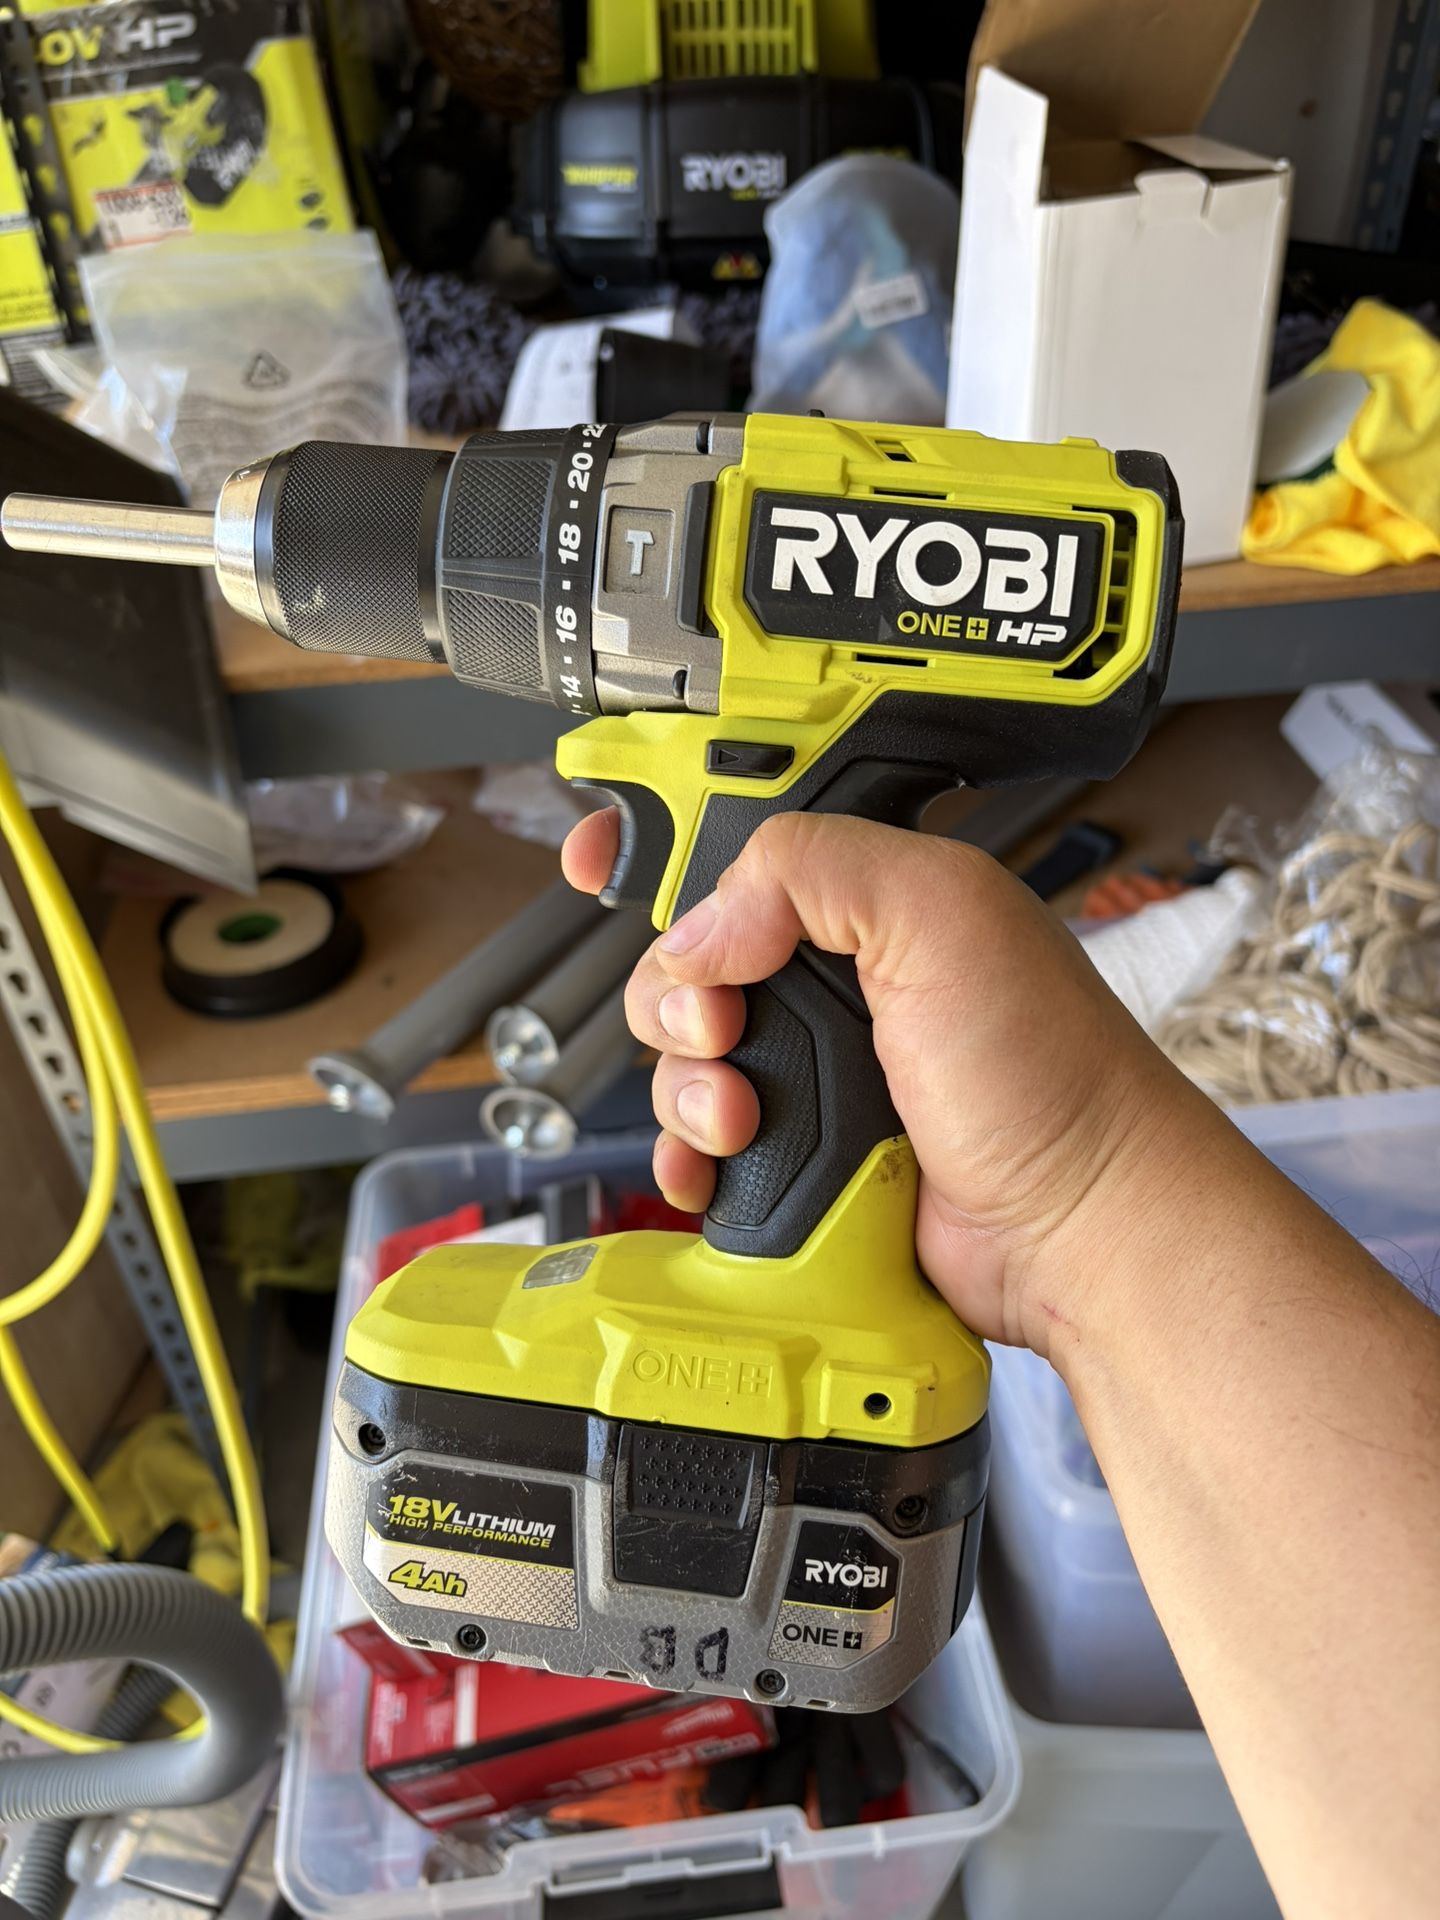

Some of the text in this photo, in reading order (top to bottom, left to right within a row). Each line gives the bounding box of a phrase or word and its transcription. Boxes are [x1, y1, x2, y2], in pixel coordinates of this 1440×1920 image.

[34, 12, 197, 66] 0V HP
[680, 152, 788, 192] RYOBI
[567, 451, 594, 493] 20
[558, 522, 582, 565] 18
[770, 507, 1079, 618] RYOBI
[555, 604, 578, 643] 16
[996, 619, 1068, 647] HP
[559, 674, 584, 698] 14
[388, 1493, 557, 1539] 18V LITHIUM
[388, 1512, 552, 1549] HIGH PERFORMANCE
[387, 1559, 468, 1598] 4Ah
[804, 1557, 889, 1589] RYOBI
